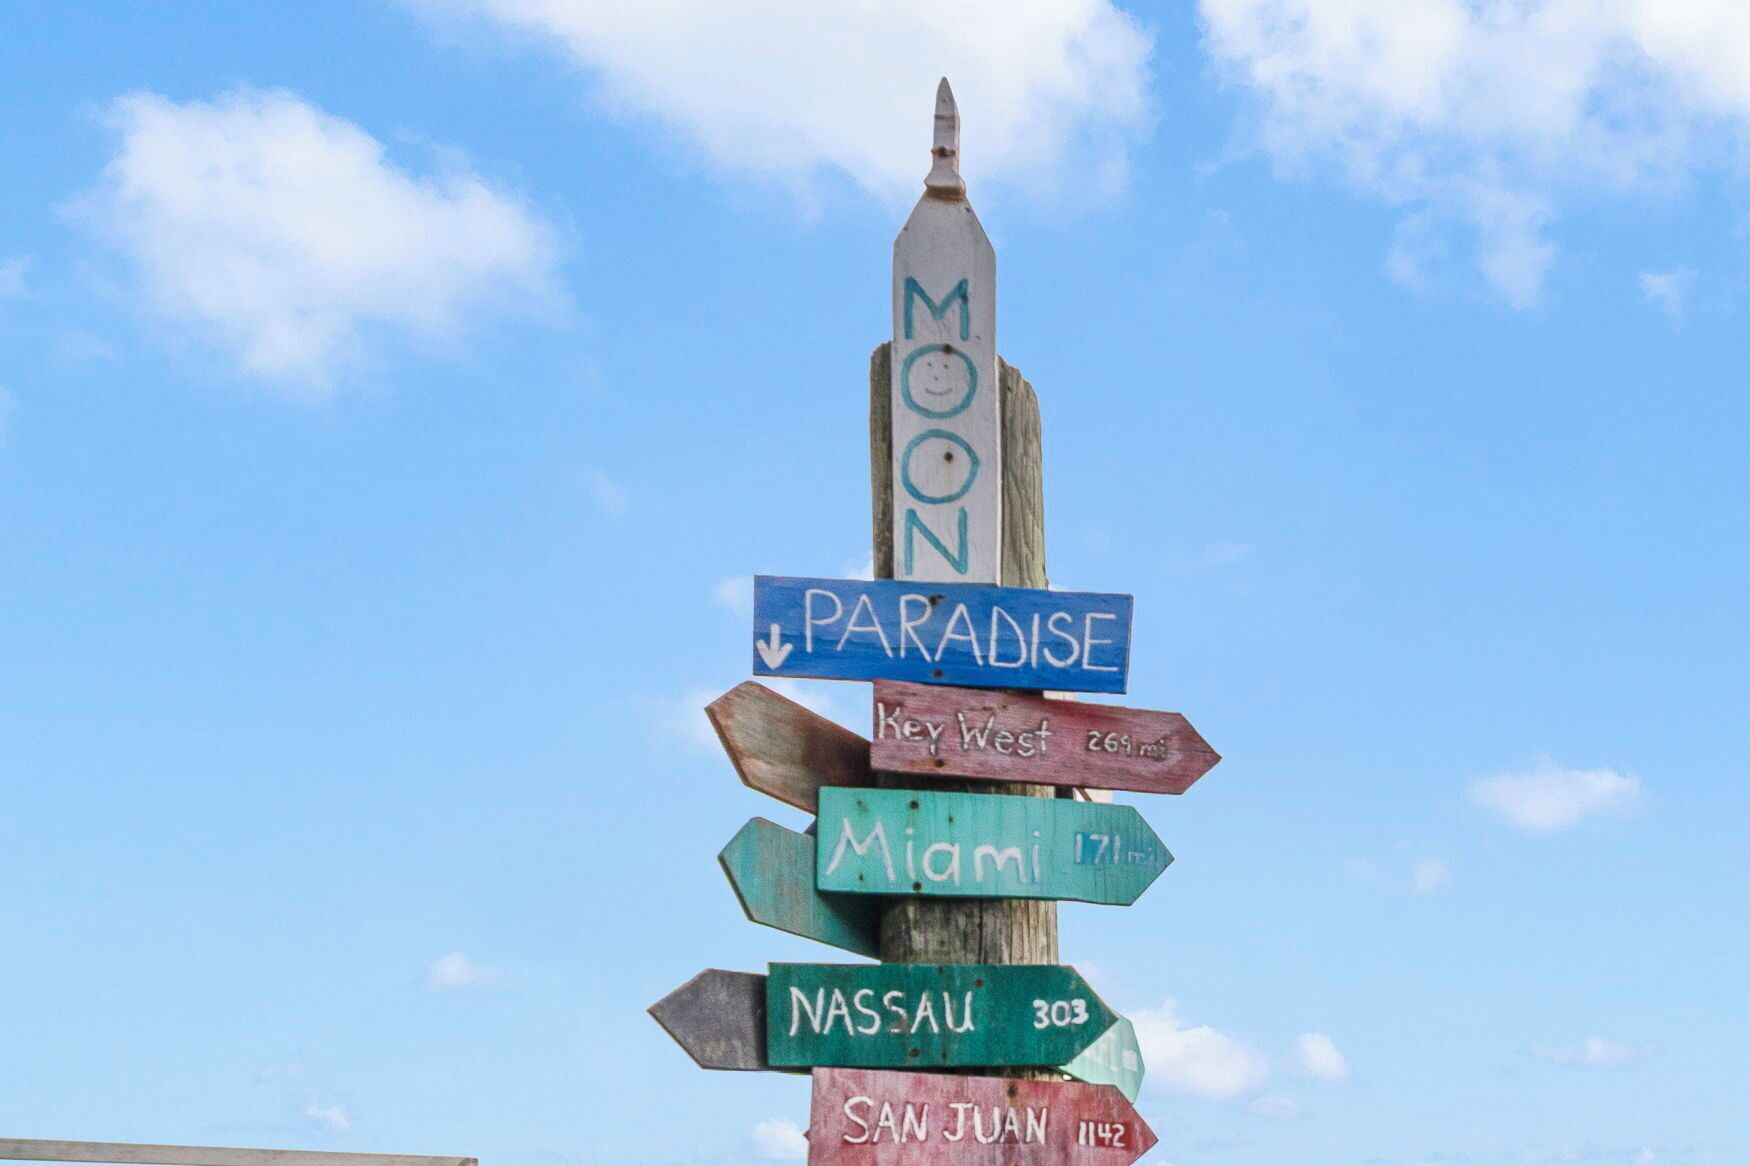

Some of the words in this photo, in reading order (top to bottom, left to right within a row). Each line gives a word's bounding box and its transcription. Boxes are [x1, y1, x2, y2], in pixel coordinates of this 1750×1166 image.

[901, 277, 980, 577] MOON
[804, 588, 1119, 672] PARADISE
[877, 702, 945, 756] Key
[956, 711, 1053, 757] West
[825, 816, 1040, 886] Miami
[788, 986, 976, 1036] NASSAU
[1032, 998, 1090, 1030] 303
[843, 1096, 929, 1144] SAN
[943, 1102, 1048, 1146] JUAN
[1078, 1121, 1126, 1148] 1142
